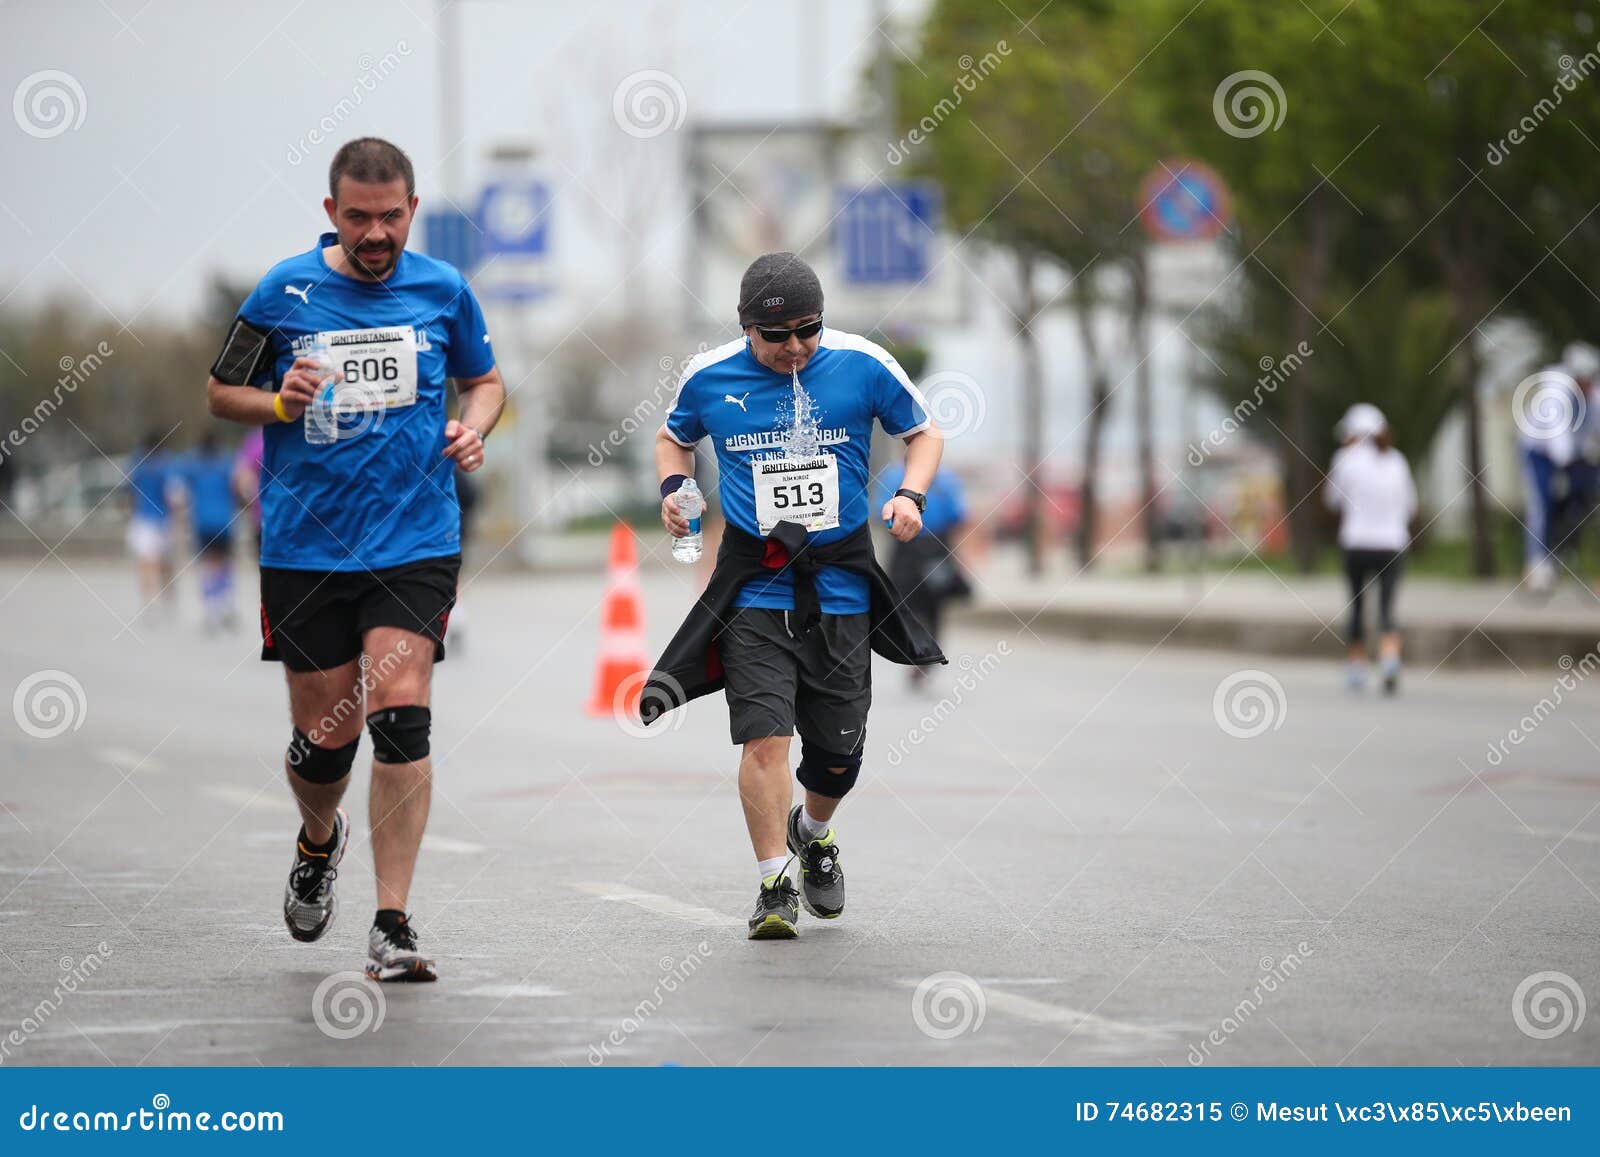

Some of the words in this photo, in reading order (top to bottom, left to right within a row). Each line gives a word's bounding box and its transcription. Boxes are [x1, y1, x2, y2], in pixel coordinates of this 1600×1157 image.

[331, 331, 404, 346] IGNITEISTANBUL
[343, 357, 398, 383] 606
[773, 482, 824, 509] 513
